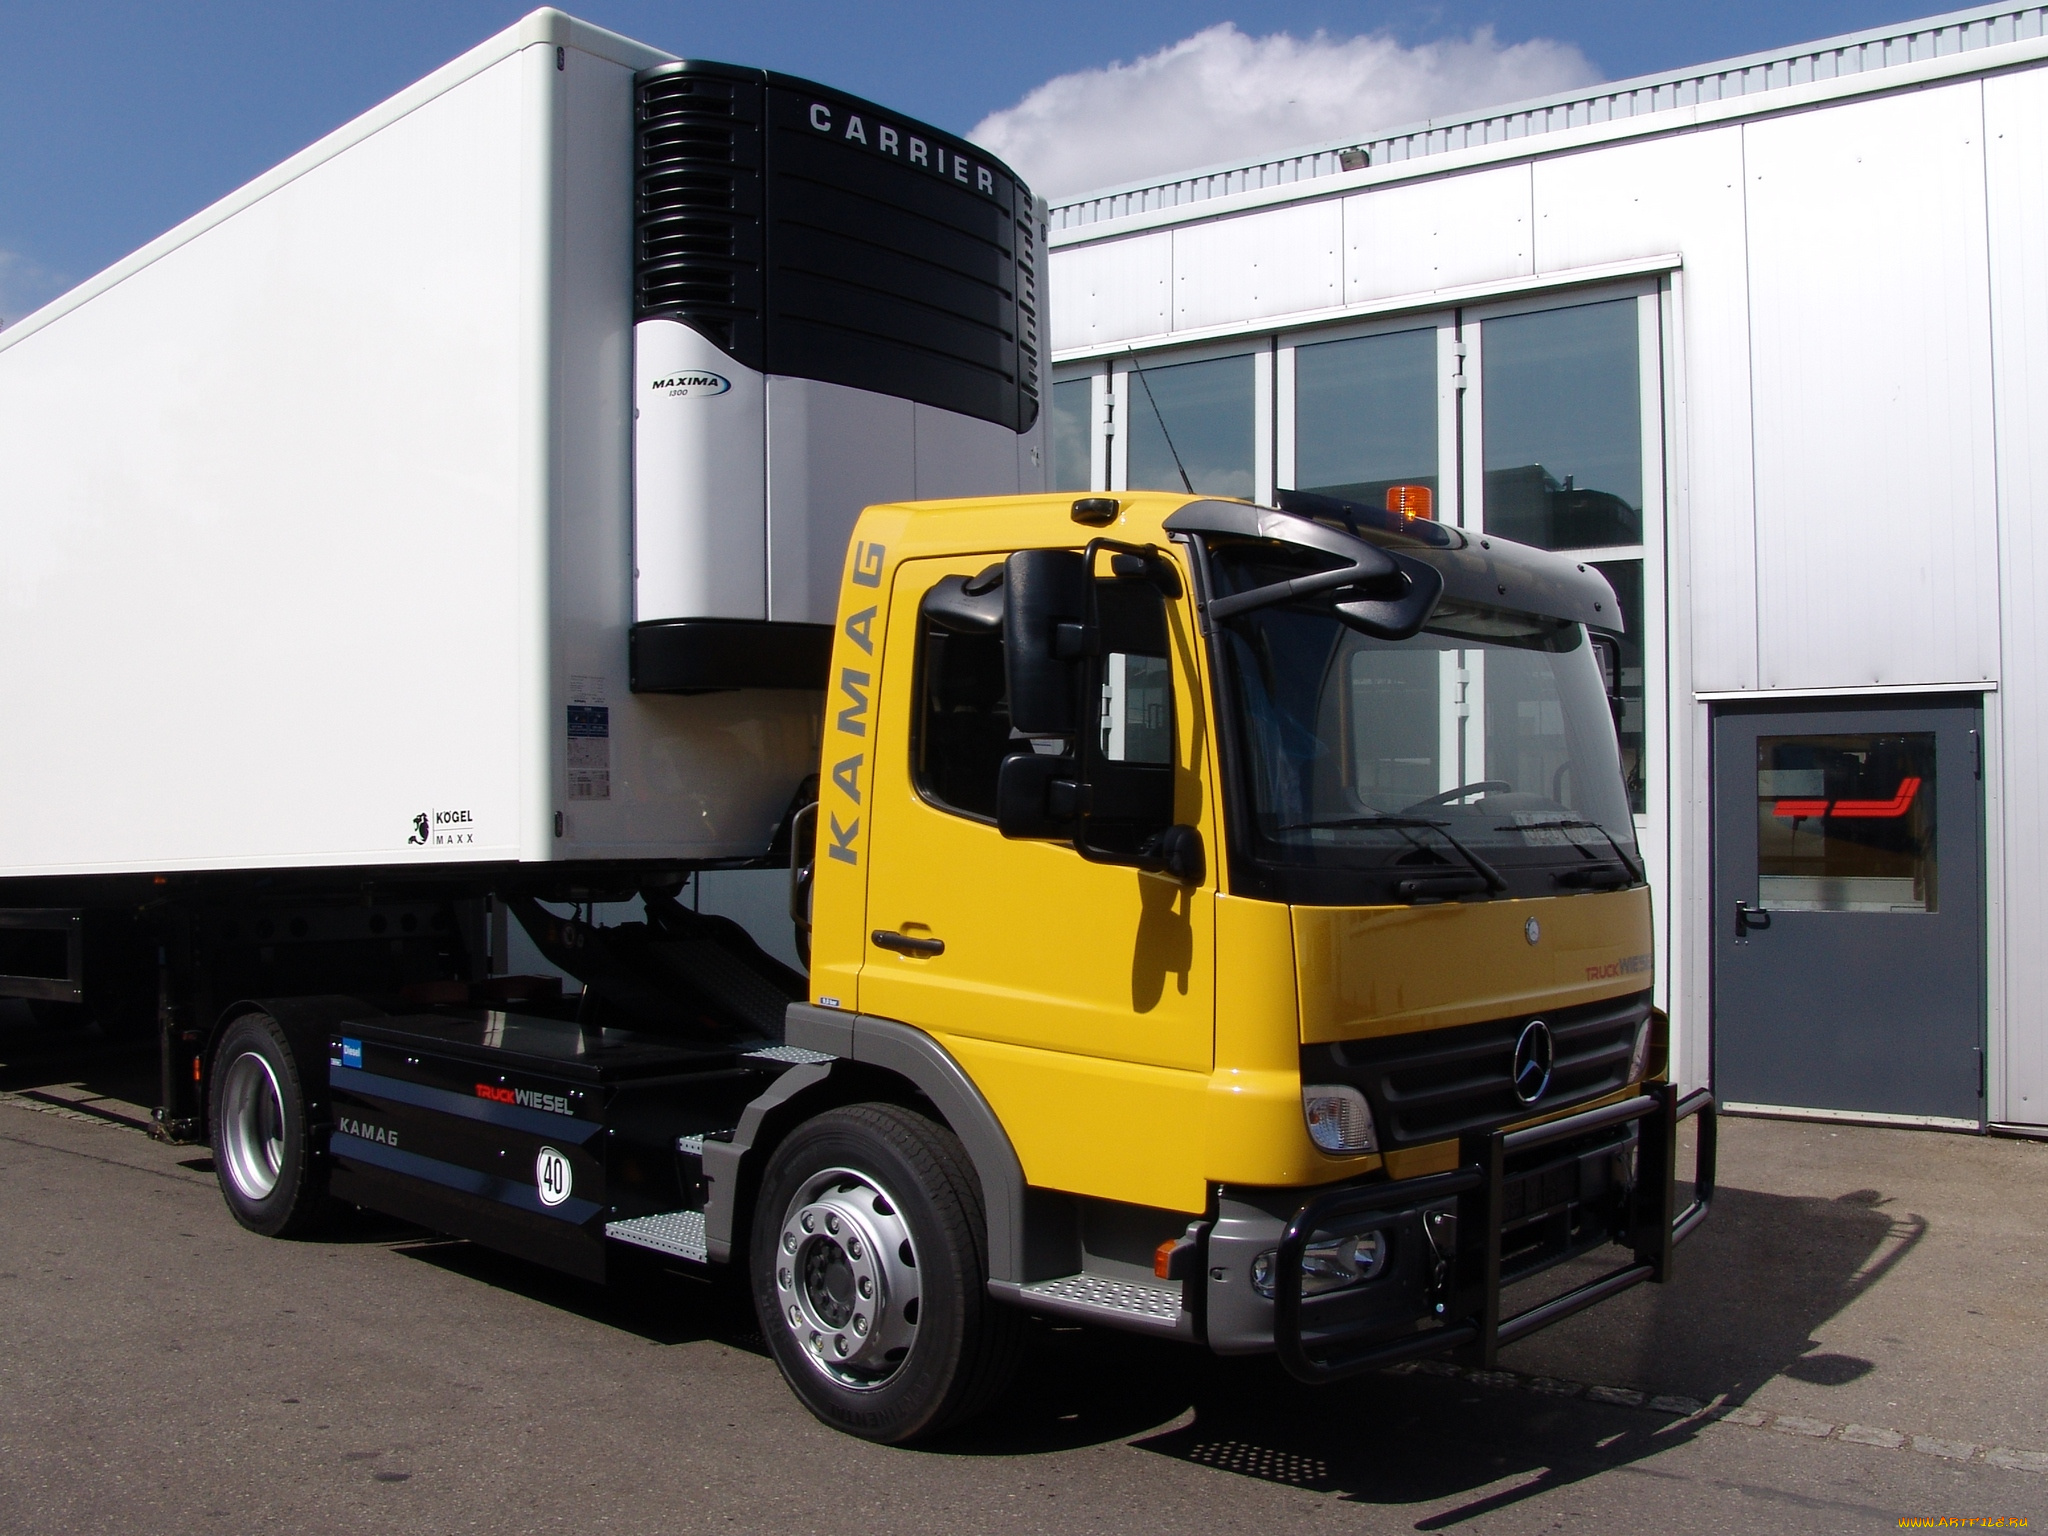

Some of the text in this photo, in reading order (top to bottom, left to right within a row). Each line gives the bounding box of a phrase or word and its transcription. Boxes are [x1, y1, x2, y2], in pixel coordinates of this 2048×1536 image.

[810, 103, 993, 195] CARRIER
[652, 377, 719, 390] MAXIMA
[669, 389, 688, 397] 1300
[828, 540, 887, 866] KAMAG
[436, 810, 473, 824] KÖGEL
[436, 833, 473, 845] MAXX
[343, 1044, 361, 1057] Diesel
[475, 1083, 574, 1116] TRUCKWIESEL
[340, 1117, 398, 1146] KAMAG
[543, 1155, 563, 1195] 40
